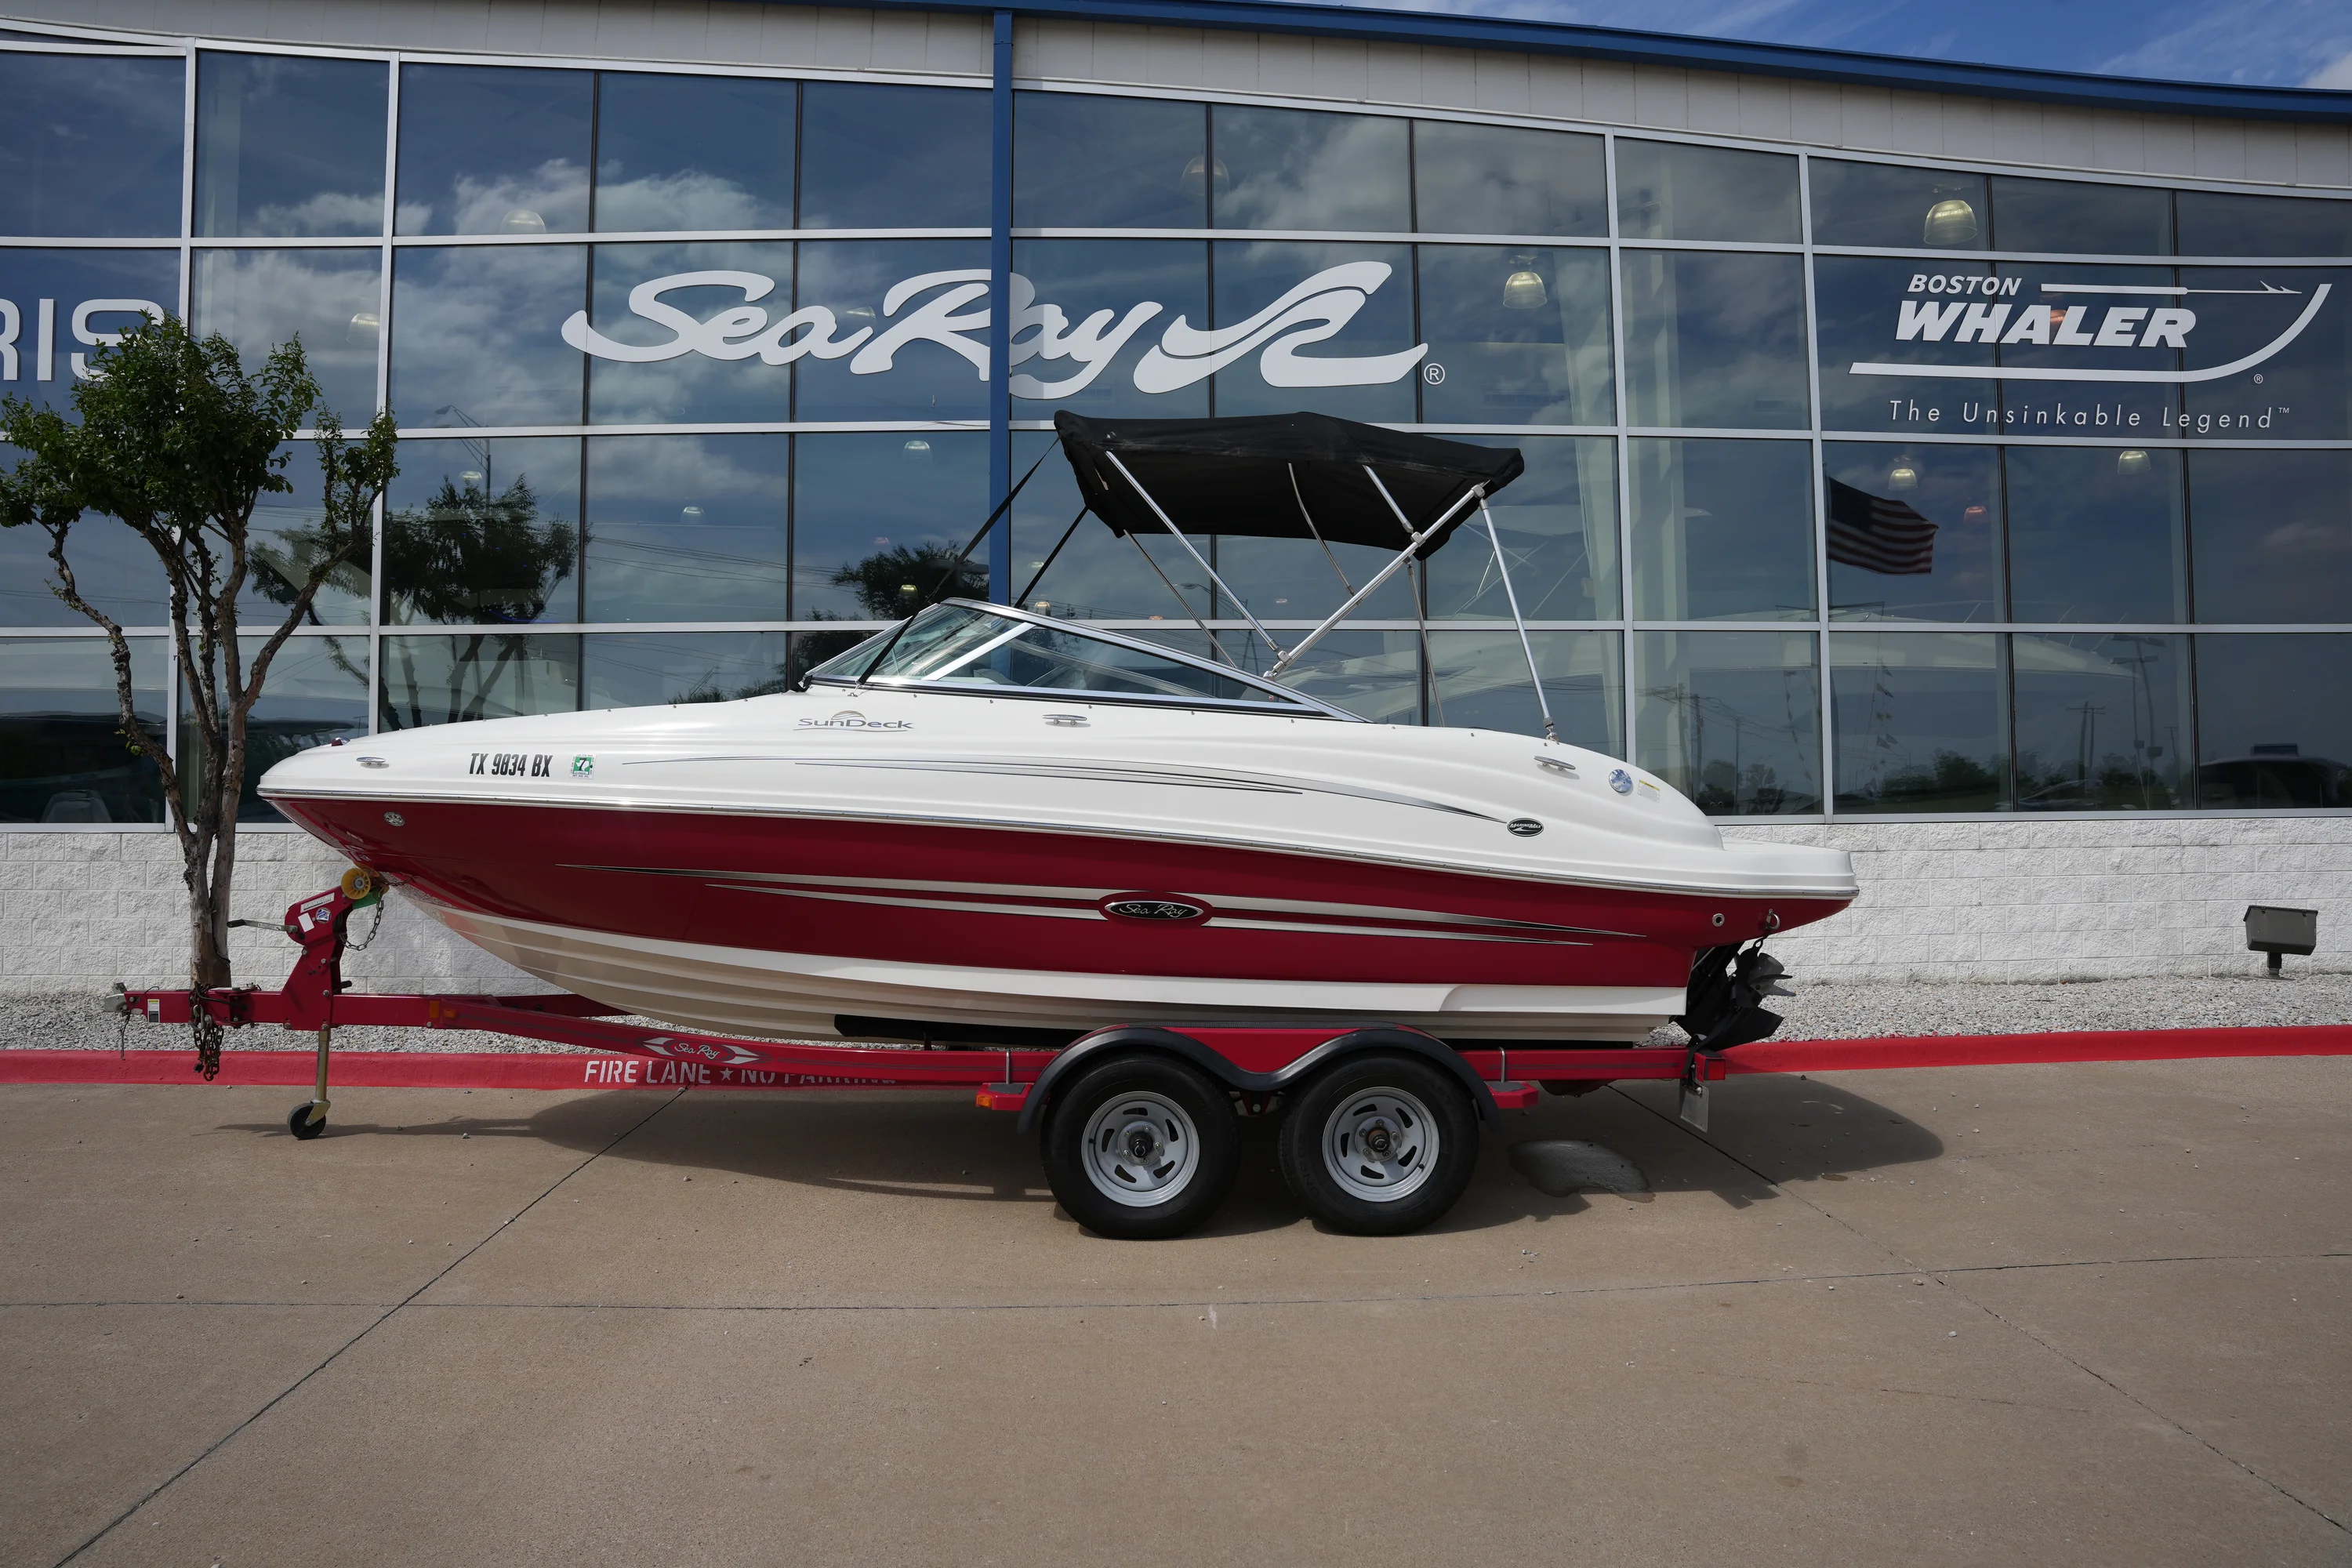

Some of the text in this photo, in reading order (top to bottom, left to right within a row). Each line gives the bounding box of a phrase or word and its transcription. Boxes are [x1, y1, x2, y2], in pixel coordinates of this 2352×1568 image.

[1907, 274, 2023, 296] BOSTON
[561, 270, 874, 365] Sea
[850, 268, 1163, 401] Ray
[1895, 299, 2197, 348] WHALER
[1889, 398, 1940, 423] The
[1962, 401, 2141, 427] Unsinkable
[798, 717, 915, 729] SunDeck
[469, 753, 554, 777] TX 9834 BX
[1119, 903, 1188, 918] Sea Ray
[673, 1043, 720, 1060] Sea Ray
[584, 1060, 639, 1083] FIRE
[646, 1060, 711, 1084] LANE
